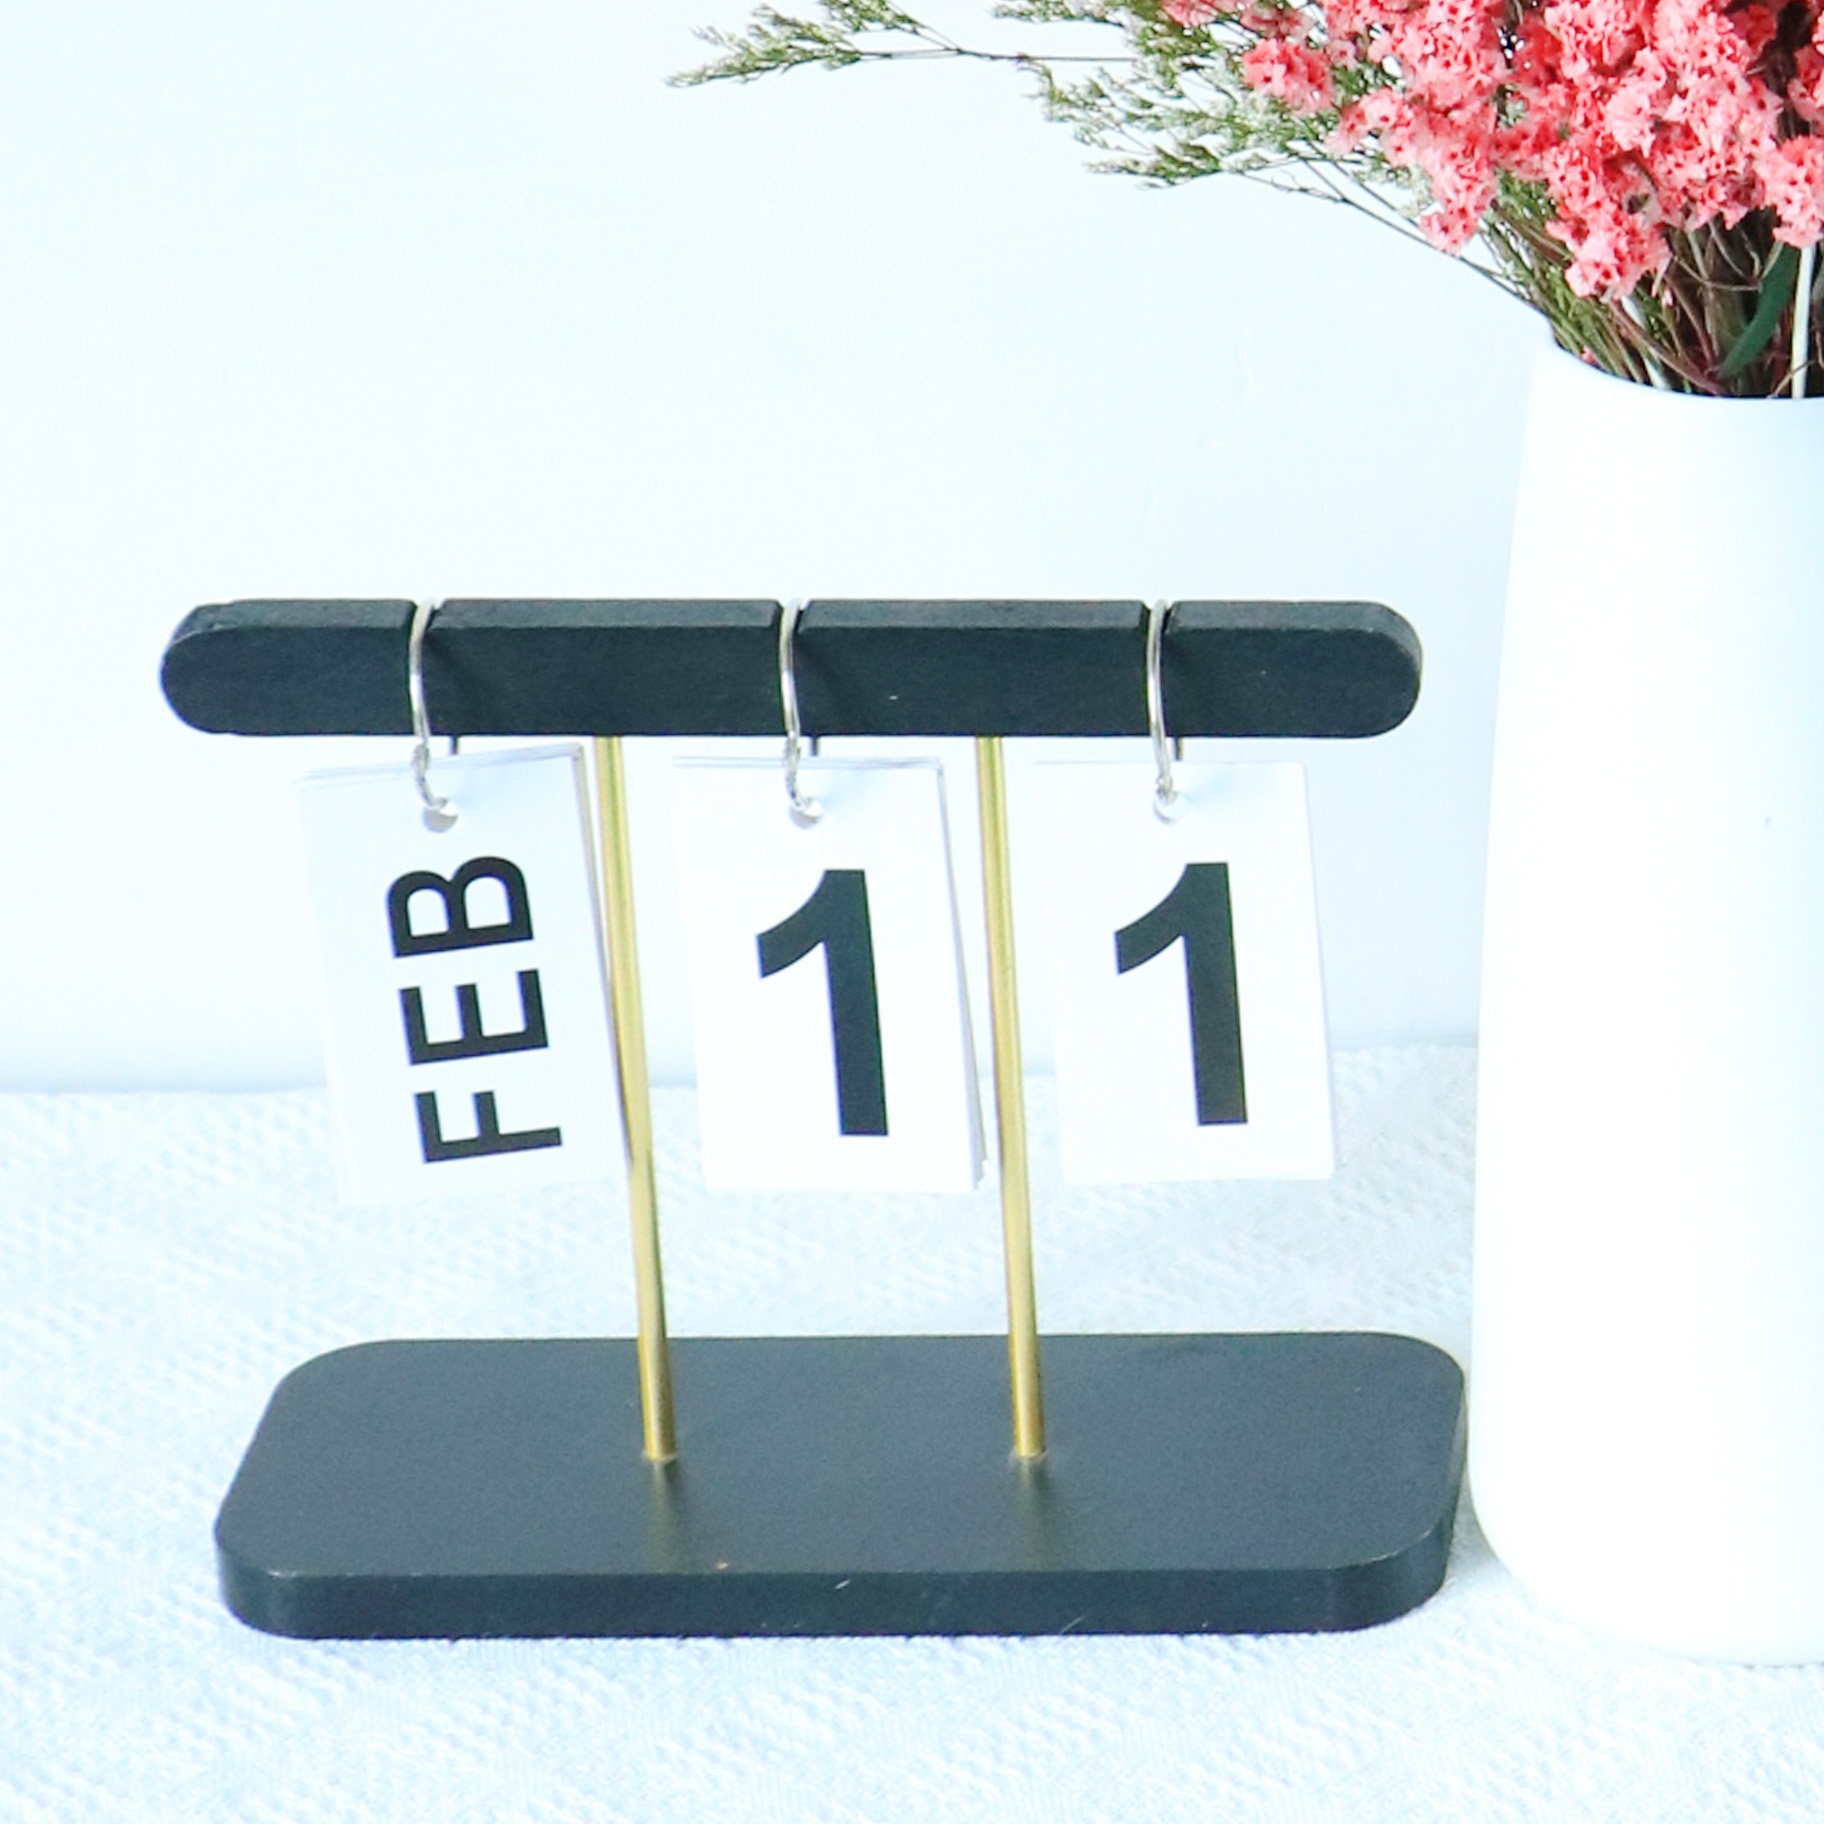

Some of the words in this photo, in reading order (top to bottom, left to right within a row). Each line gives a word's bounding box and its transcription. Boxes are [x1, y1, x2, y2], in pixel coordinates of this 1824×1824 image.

[384, 852, 563, 1165] FEB
[755, 867, 890, 1138] 1
[1112, 860, 1250, 1128] 1
